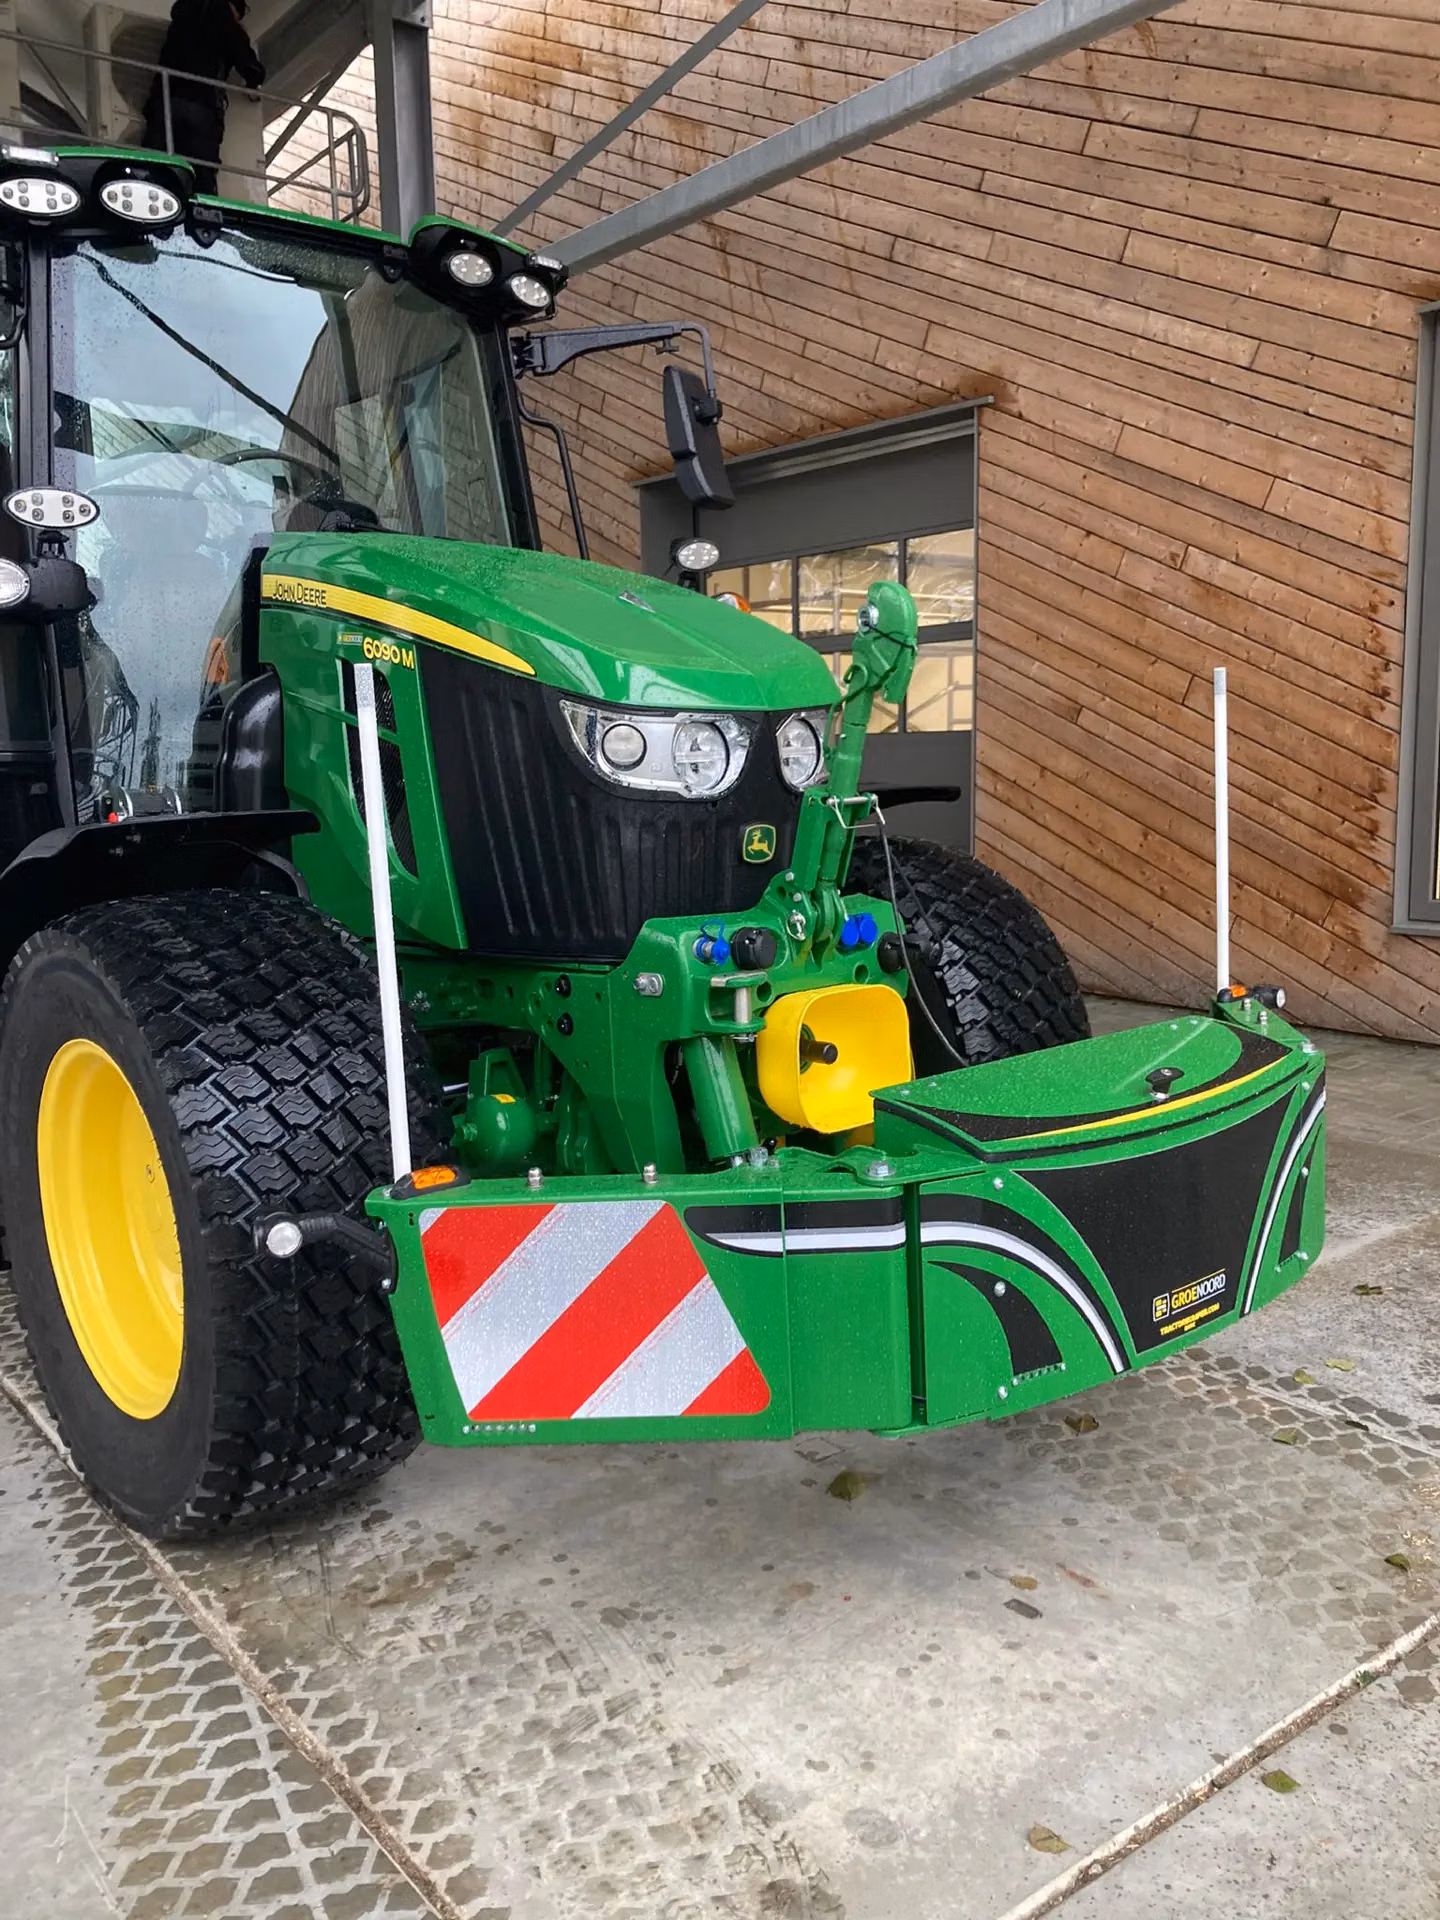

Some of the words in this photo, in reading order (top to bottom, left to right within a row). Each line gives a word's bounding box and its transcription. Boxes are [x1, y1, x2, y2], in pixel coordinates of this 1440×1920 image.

[272, 579, 296, 600] JOHN
[296, 583, 327, 605] DEERE
[363, 637, 400, 663] 6090
[402, 648, 415, 669] M
[1171, 1273, 1226, 1309] GROENOORD
